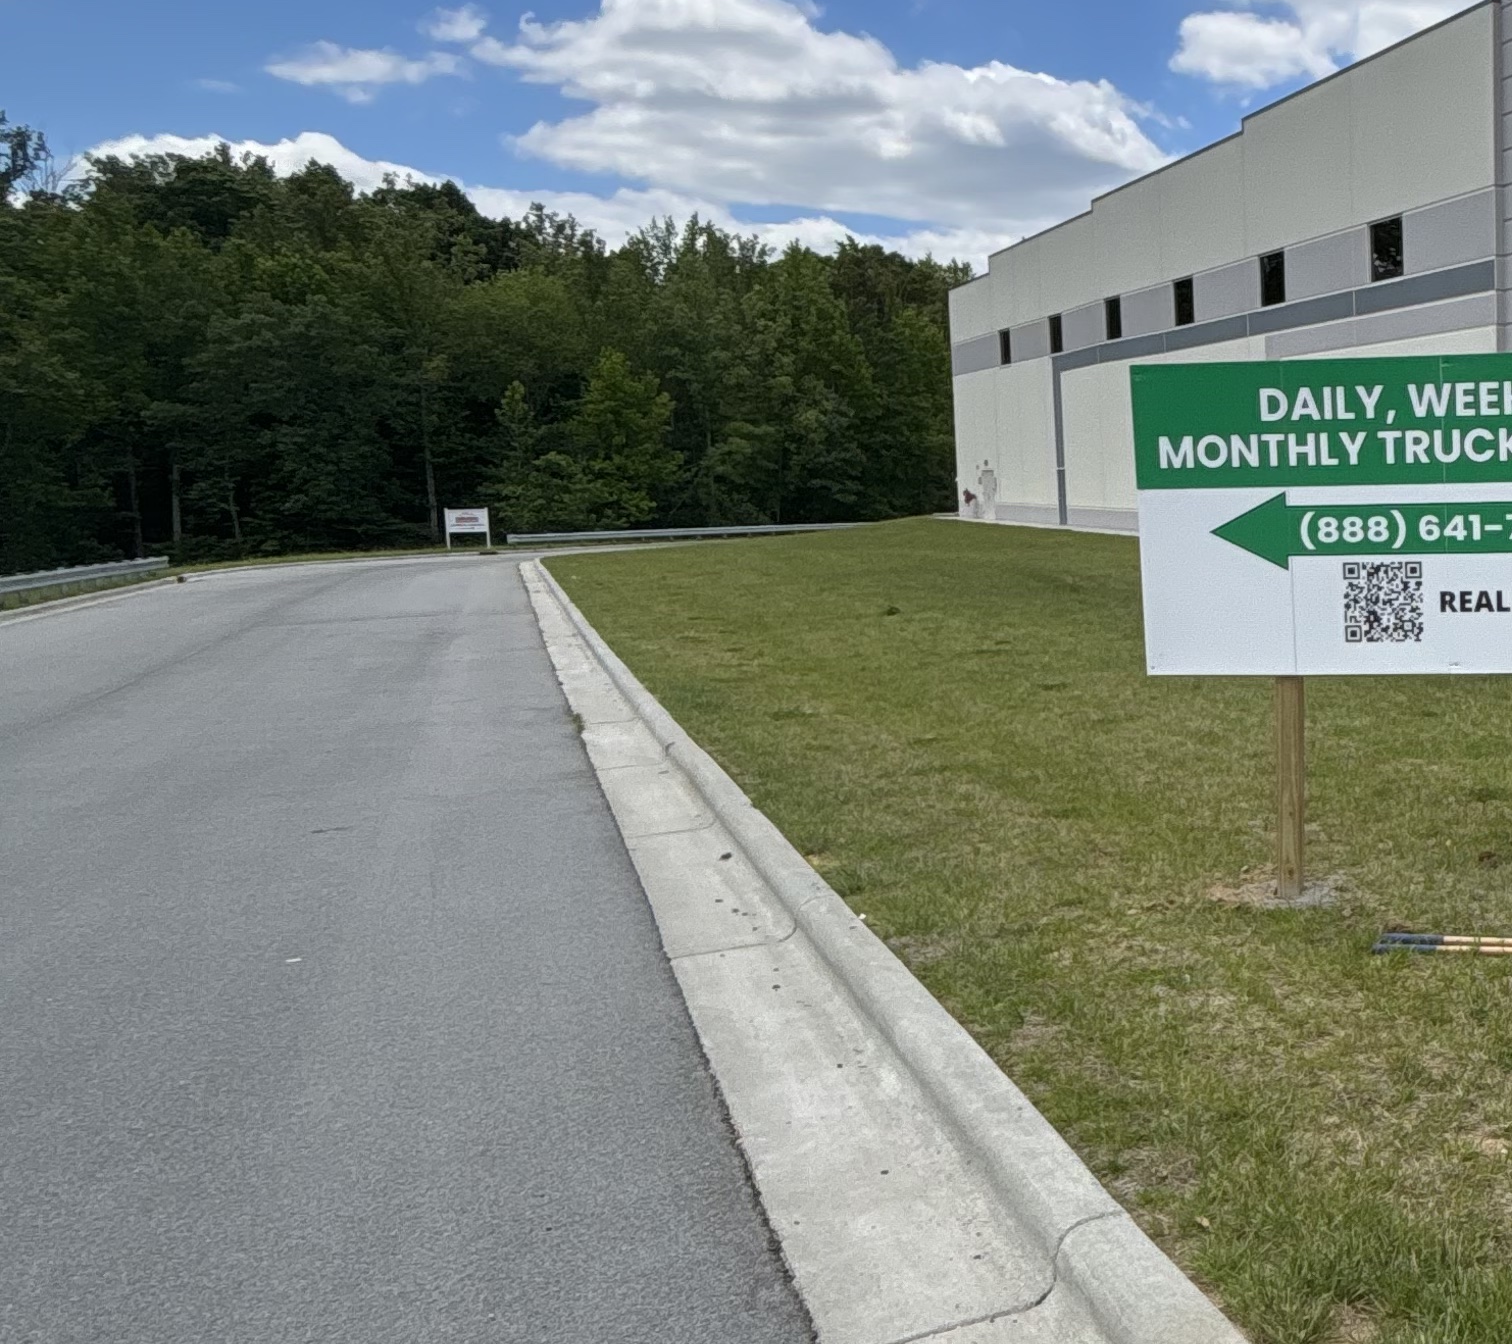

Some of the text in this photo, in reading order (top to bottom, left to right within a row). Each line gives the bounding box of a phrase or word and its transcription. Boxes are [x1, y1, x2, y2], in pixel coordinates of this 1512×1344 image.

[1258, 384, 1397, 425] DAILY,
[1158, 431, 1368, 469] MONTHLY
[1299, 509, 1407, 551] (888)
